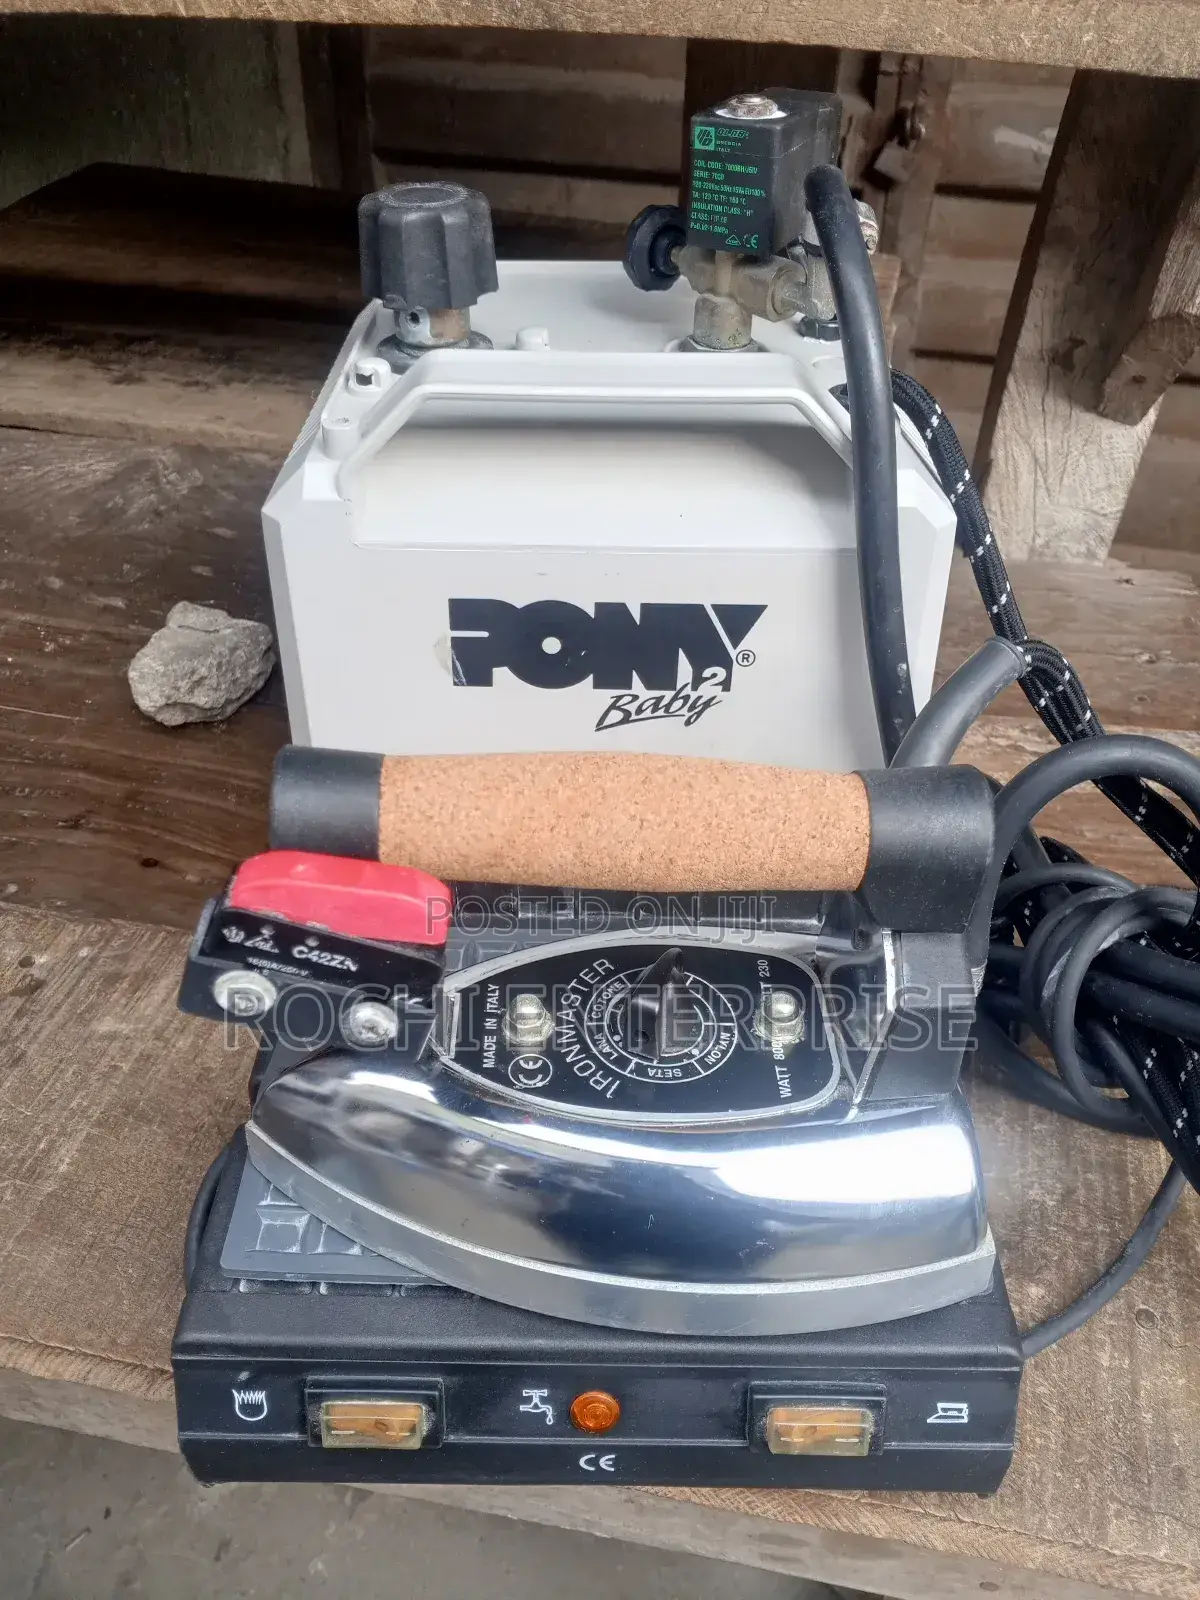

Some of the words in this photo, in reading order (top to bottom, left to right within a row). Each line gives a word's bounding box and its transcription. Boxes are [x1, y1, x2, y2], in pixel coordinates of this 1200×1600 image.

[693, 159, 706, 168] COIL
[691, 201, 723, 213] INSULATION
[448, 598, 768, 692] PONY
[594, 682, 723, 732] Baby
[757, 959, 771, 978] 230
[483, 983, 500, 1014] ITALY
[591, 980, 625, 1019] COTONE
[483, 1018, 497, 1030] IN
[554, 958, 621, 1099] IRONMASTER
[482, 1035, 497, 1068] MADE
[593, 1032, 619, 1060] LANA
[703, 1031, 731, 1066] NYLON
[518, 1059, 543, 1086] CE
[647, 1067, 683, 1079] SETA
[774, 1065, 793, 1099] WATT
[579, 1454, 616, 1472] CE
